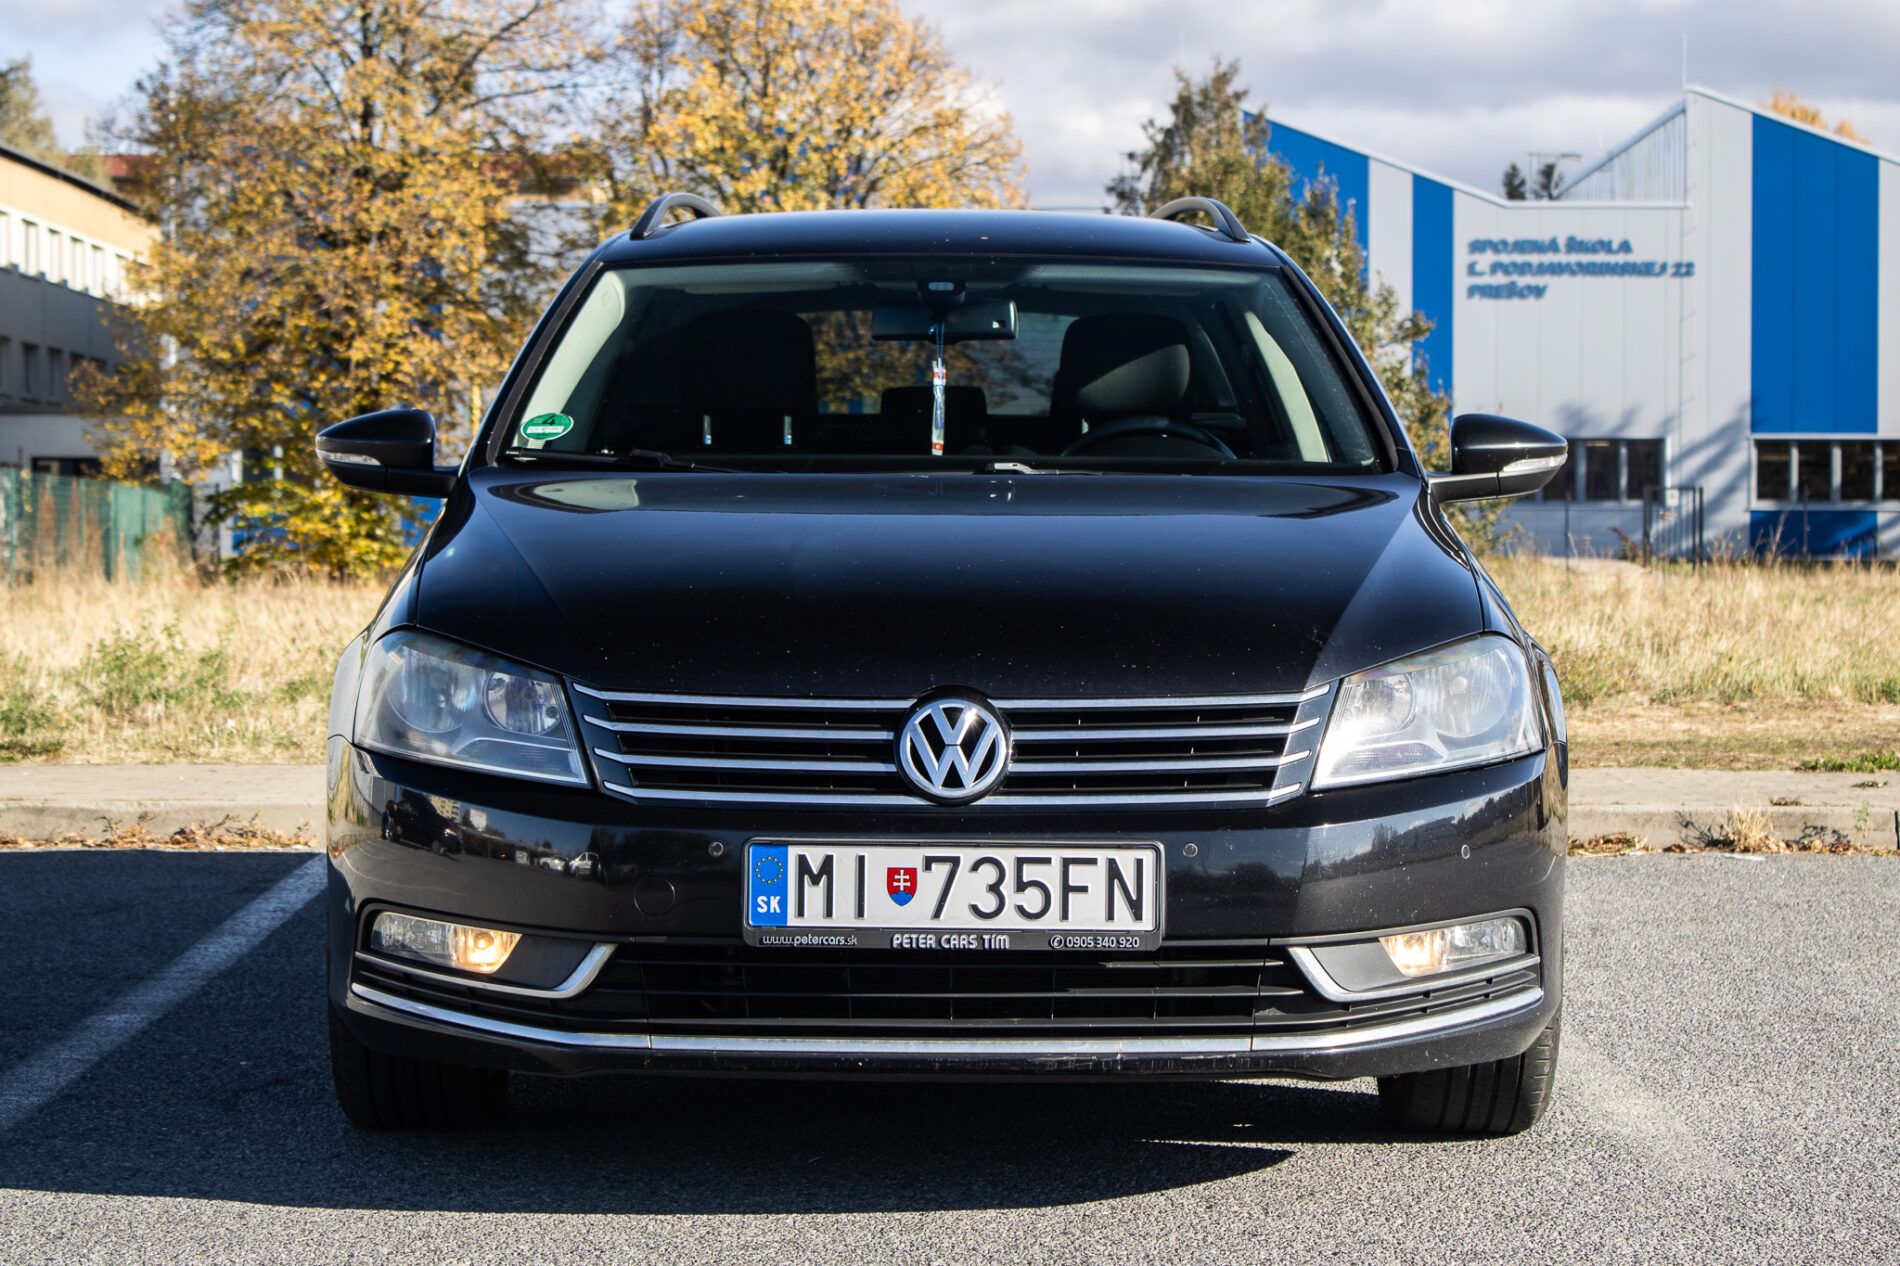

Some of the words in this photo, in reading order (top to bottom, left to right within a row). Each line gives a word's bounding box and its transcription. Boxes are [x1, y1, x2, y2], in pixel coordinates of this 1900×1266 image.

[1467, 281, 1548, 300] PREŠOV
[541, 414, 556, 426] 4
[796, 853, 866, 919] MI
[922, 854, 1144, 922] 735FN
[757, 895, 781, 914] SK
[762, 934, 858, 947] www.petercars.sk
[892, 933, 936, 949] PETER
[940, 934, 978, 949] CARS
[1066, 936, 1094, 948] 0905
[1096, 936, 1117, 948] 340
[1119, 936, 1140, 948] 920
